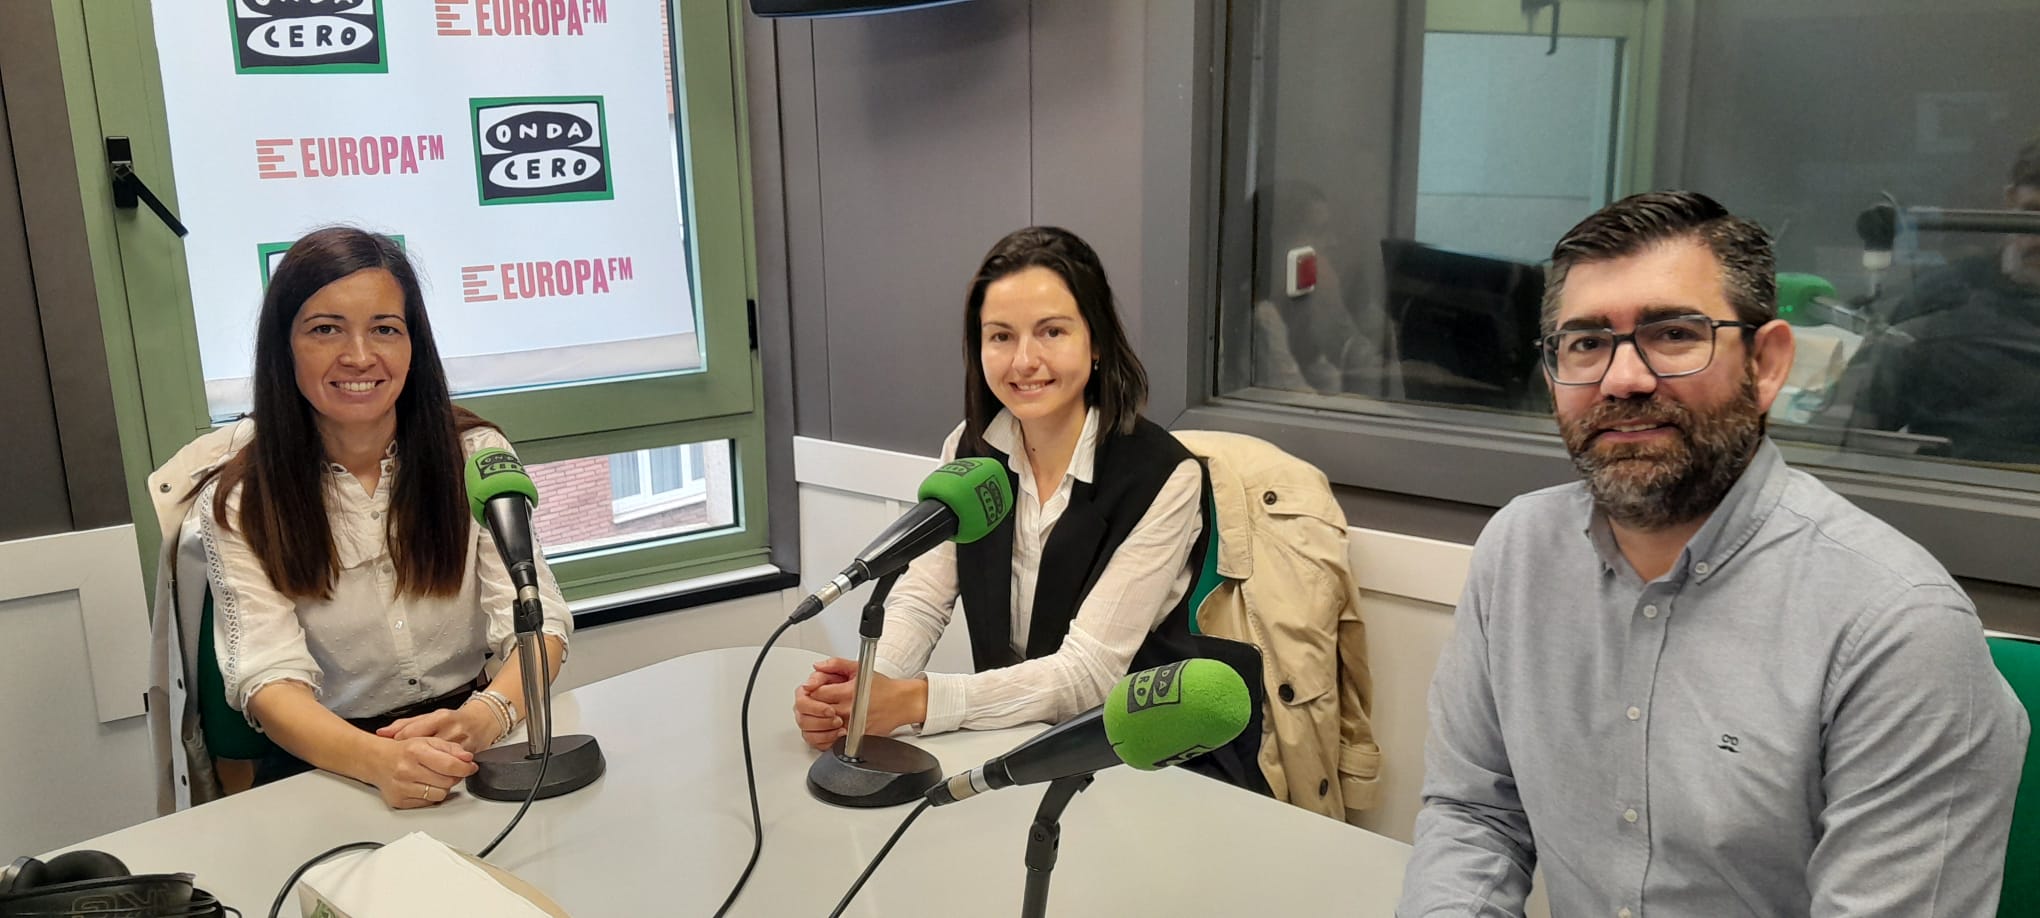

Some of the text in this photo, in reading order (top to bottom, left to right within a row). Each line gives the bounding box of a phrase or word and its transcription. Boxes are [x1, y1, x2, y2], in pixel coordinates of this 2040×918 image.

[264, 25, 357, 48] CERO
[496, 122, 583, 143] ONDA
[504, 158, 587, 180] CERO
